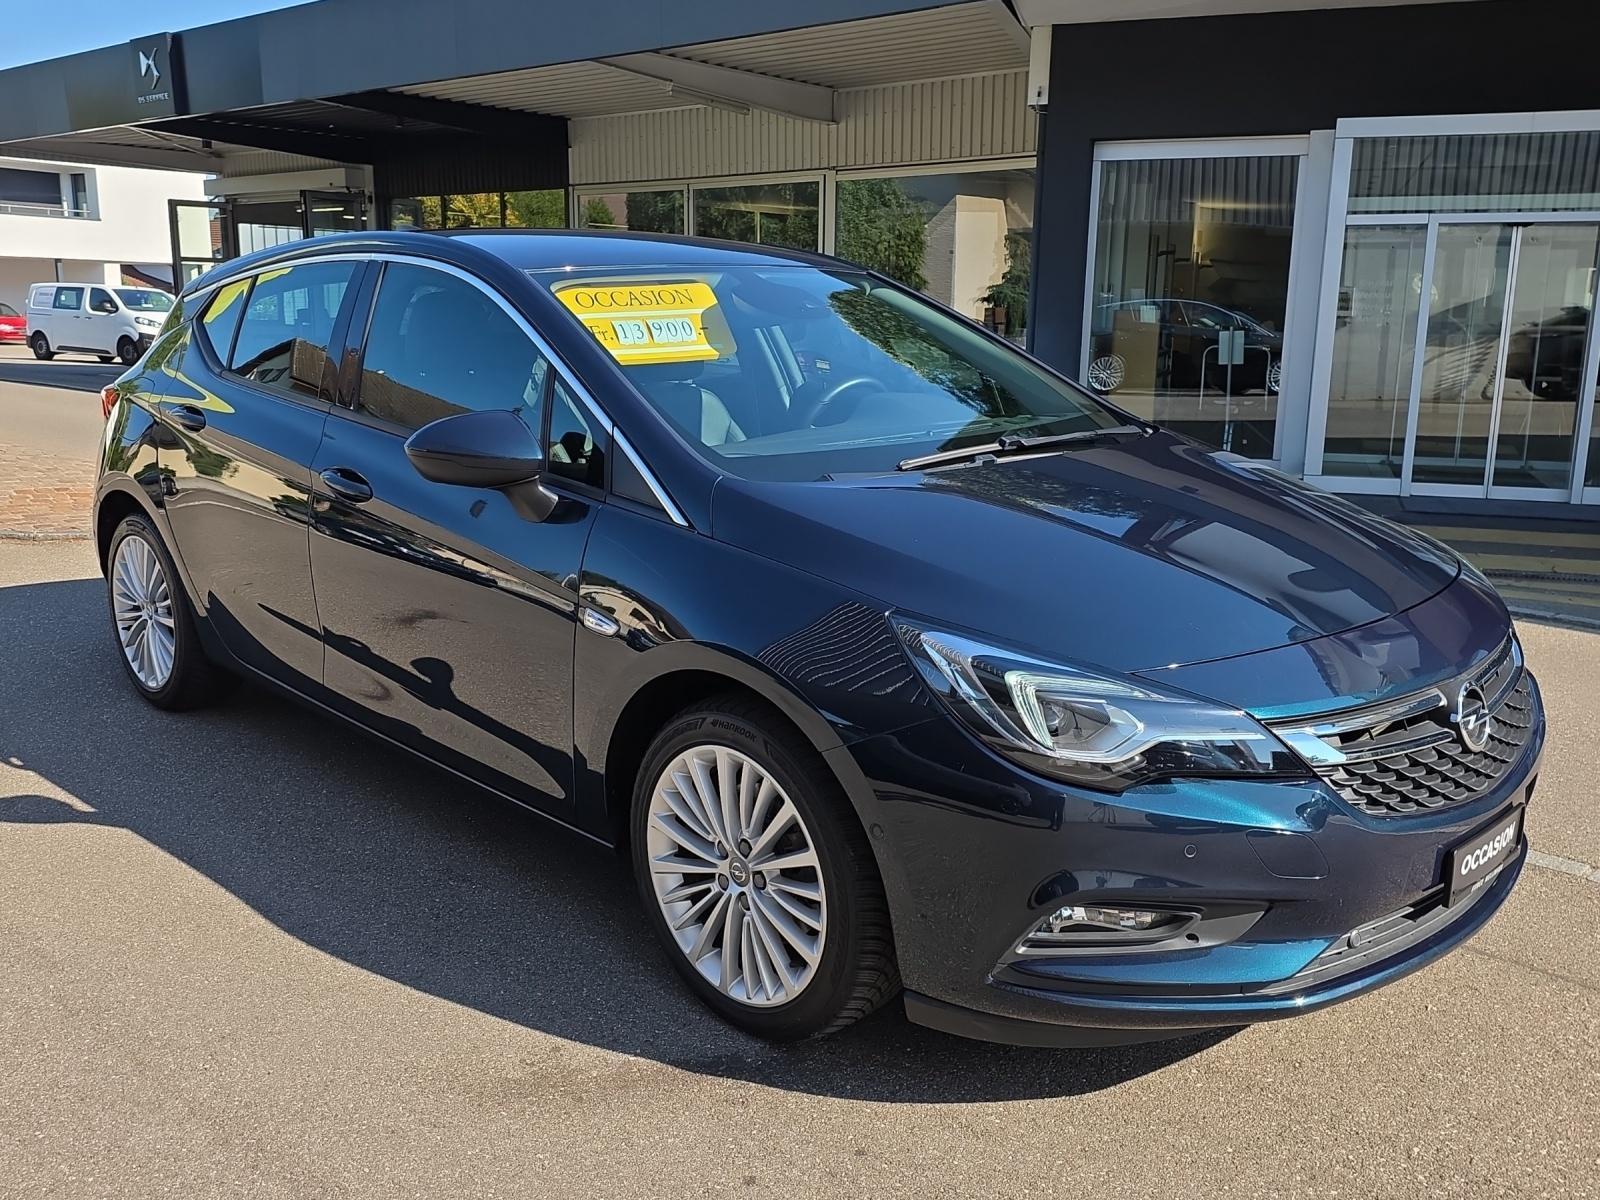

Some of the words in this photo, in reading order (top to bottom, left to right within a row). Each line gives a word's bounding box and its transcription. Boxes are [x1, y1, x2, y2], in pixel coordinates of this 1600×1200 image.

[575, 289, 694, 309] OCCASION
[588, 325, 614, 341] Fr.
[1460, 821, 1517, 876] OCCASION
